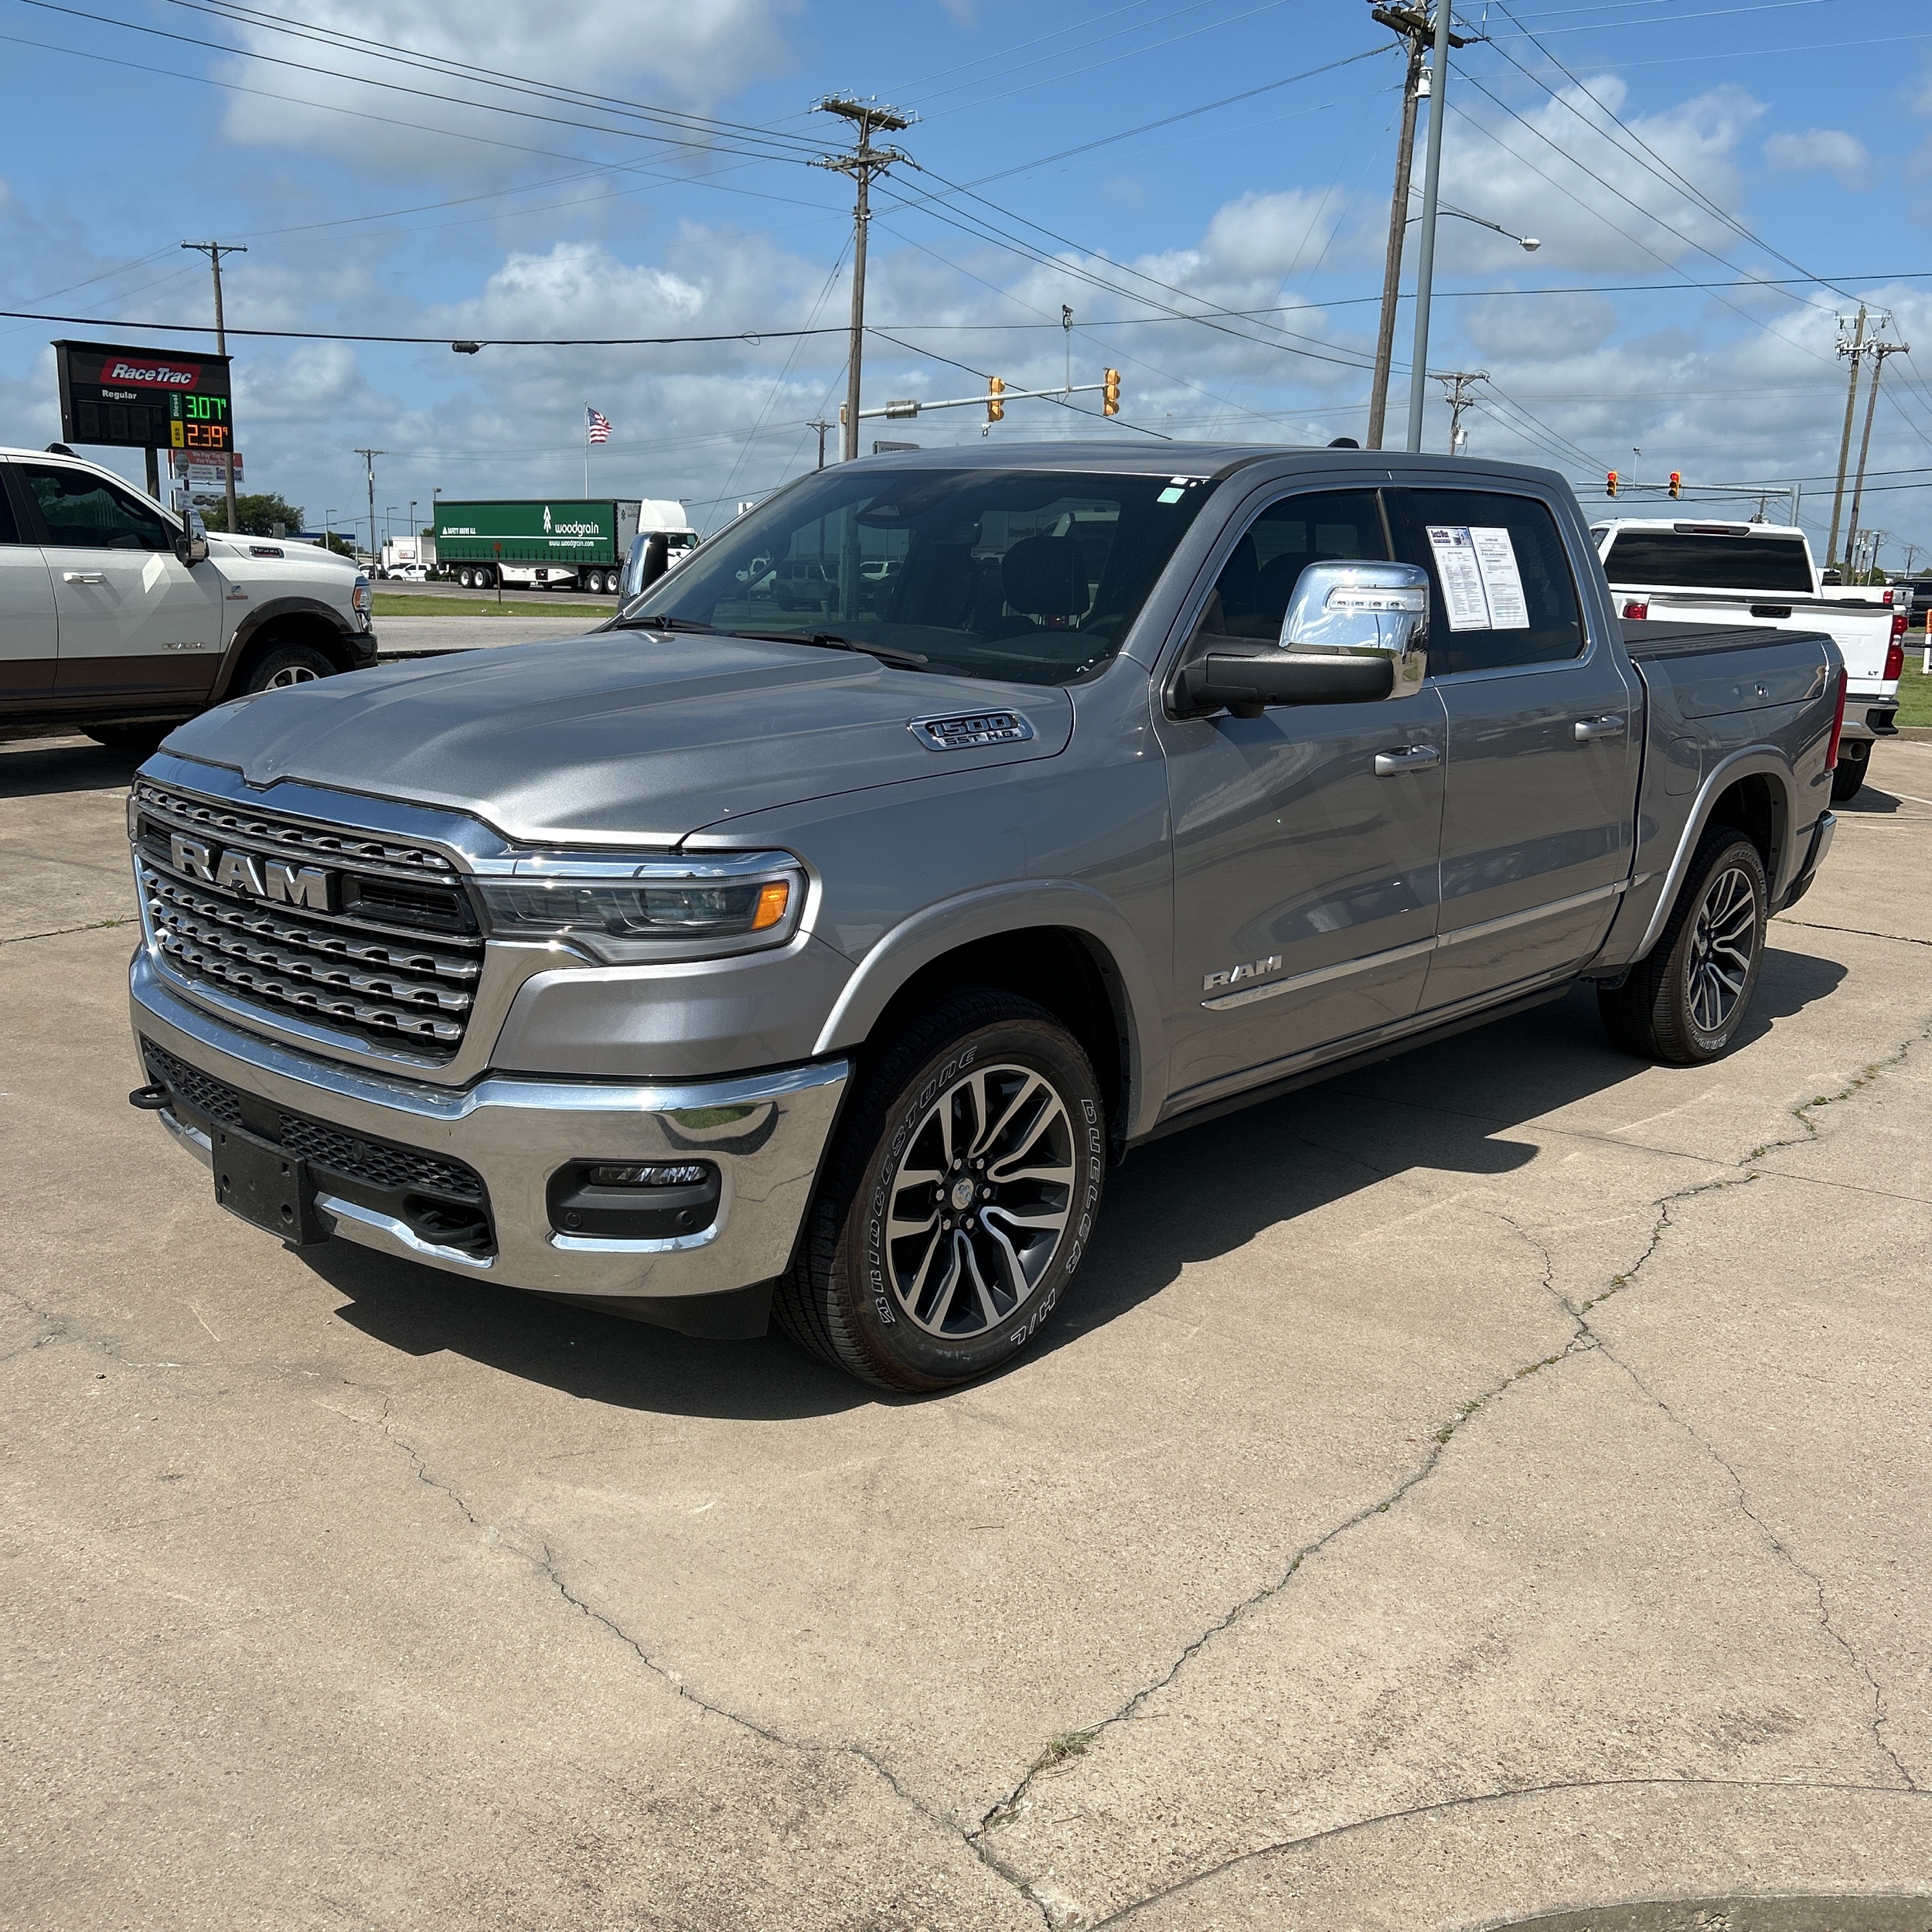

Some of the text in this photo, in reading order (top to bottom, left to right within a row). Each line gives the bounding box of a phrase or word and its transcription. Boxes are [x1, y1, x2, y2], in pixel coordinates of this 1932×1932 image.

[111, 363, 193, 384] RaceTrac
[102, 389, 137, 400] Regular
[554, 520, 599, 537] woodgrain
[548, 540, 595, 549] www.woodgrain.com
[929, 715, 1011, 738] 1500
[171, 832, 334, 911] RAM
[1203, 954, 1283, 990] RAM
[1220, 984, 1281, 1007] LIMITED
[868, 1046, 978, 1324] BRIDGESTONE
[1065, 1099, 1101, 1274] DUELER
